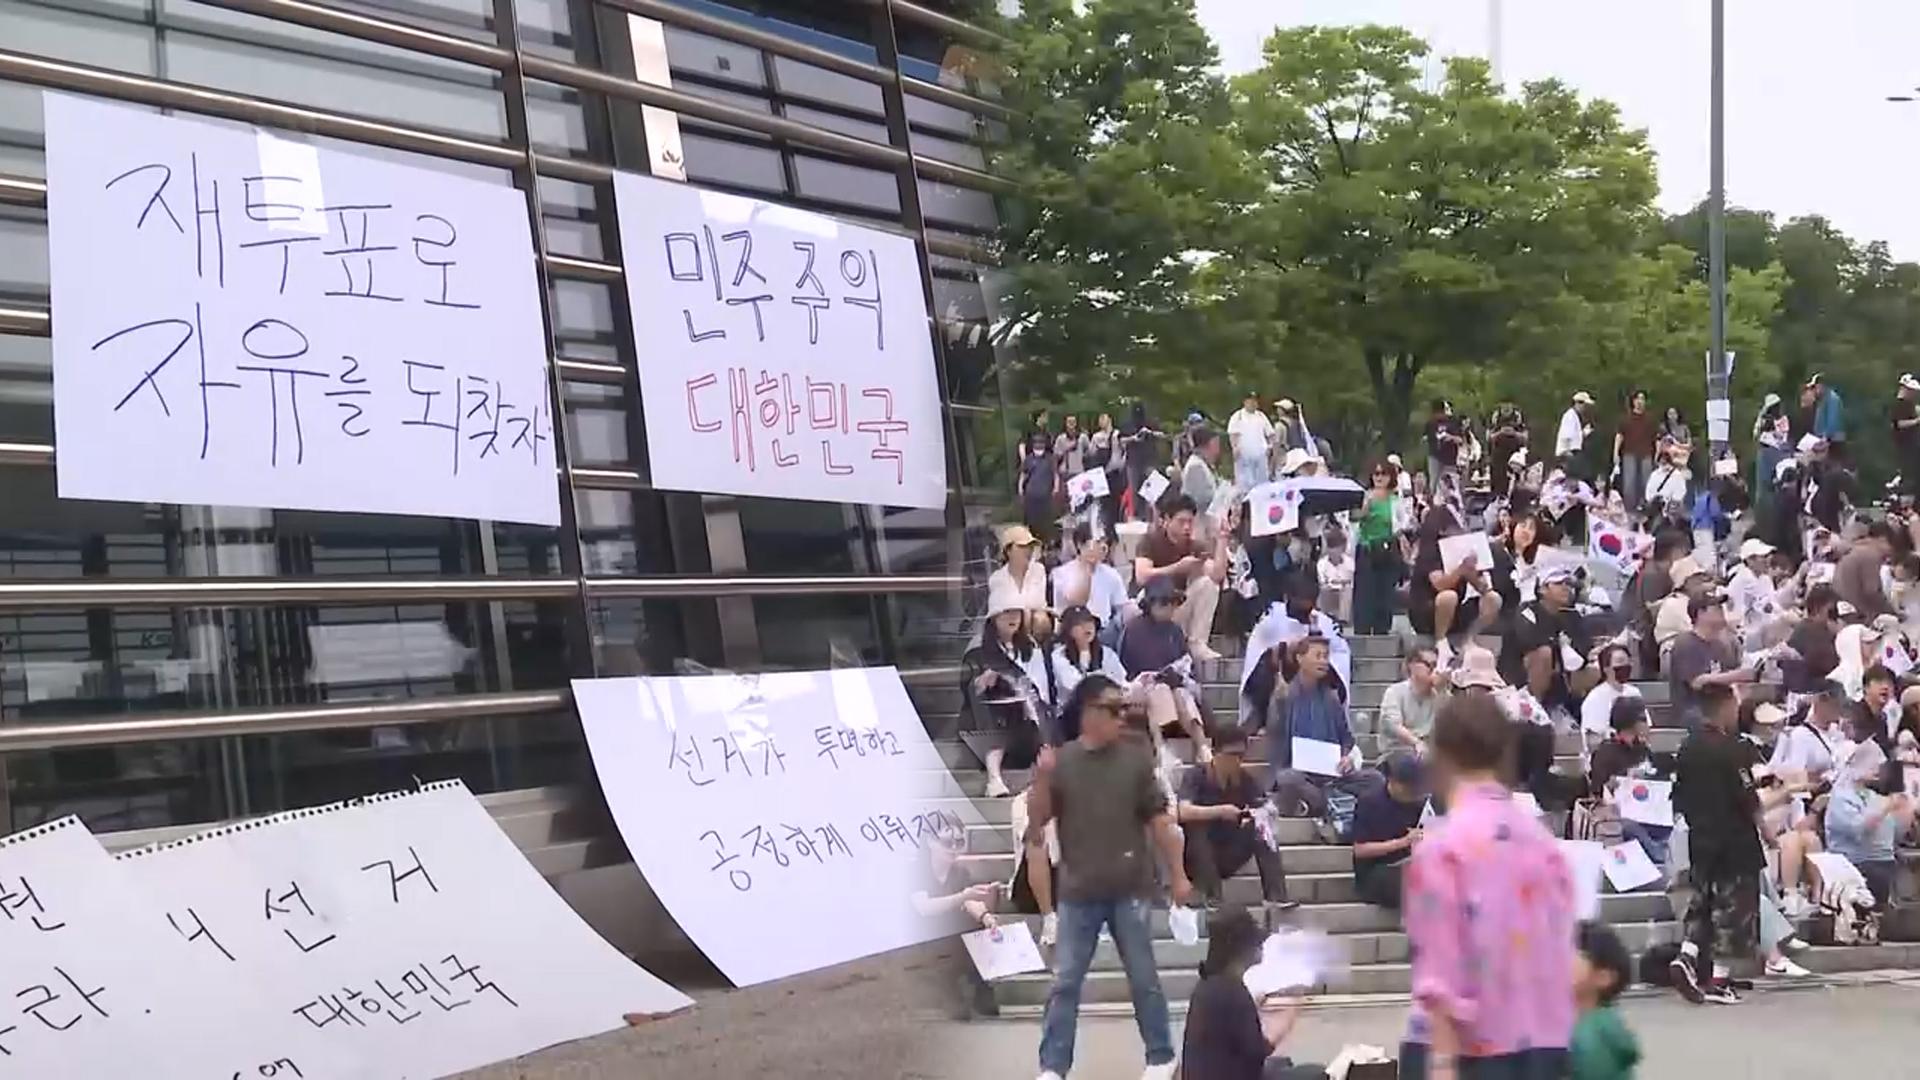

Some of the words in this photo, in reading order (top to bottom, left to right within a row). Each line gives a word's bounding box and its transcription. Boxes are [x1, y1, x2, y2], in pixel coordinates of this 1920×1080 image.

[105, 151, 481, 308] 재투표로
[91, 301, 372, 467] 자유를
[686, 367, 909, 485] 대한민국
[814, 725, 905, 770] 투명하고
[699, 822, 853, 892] 공정하게
[291, 953, 518, 1028] 대한민국
